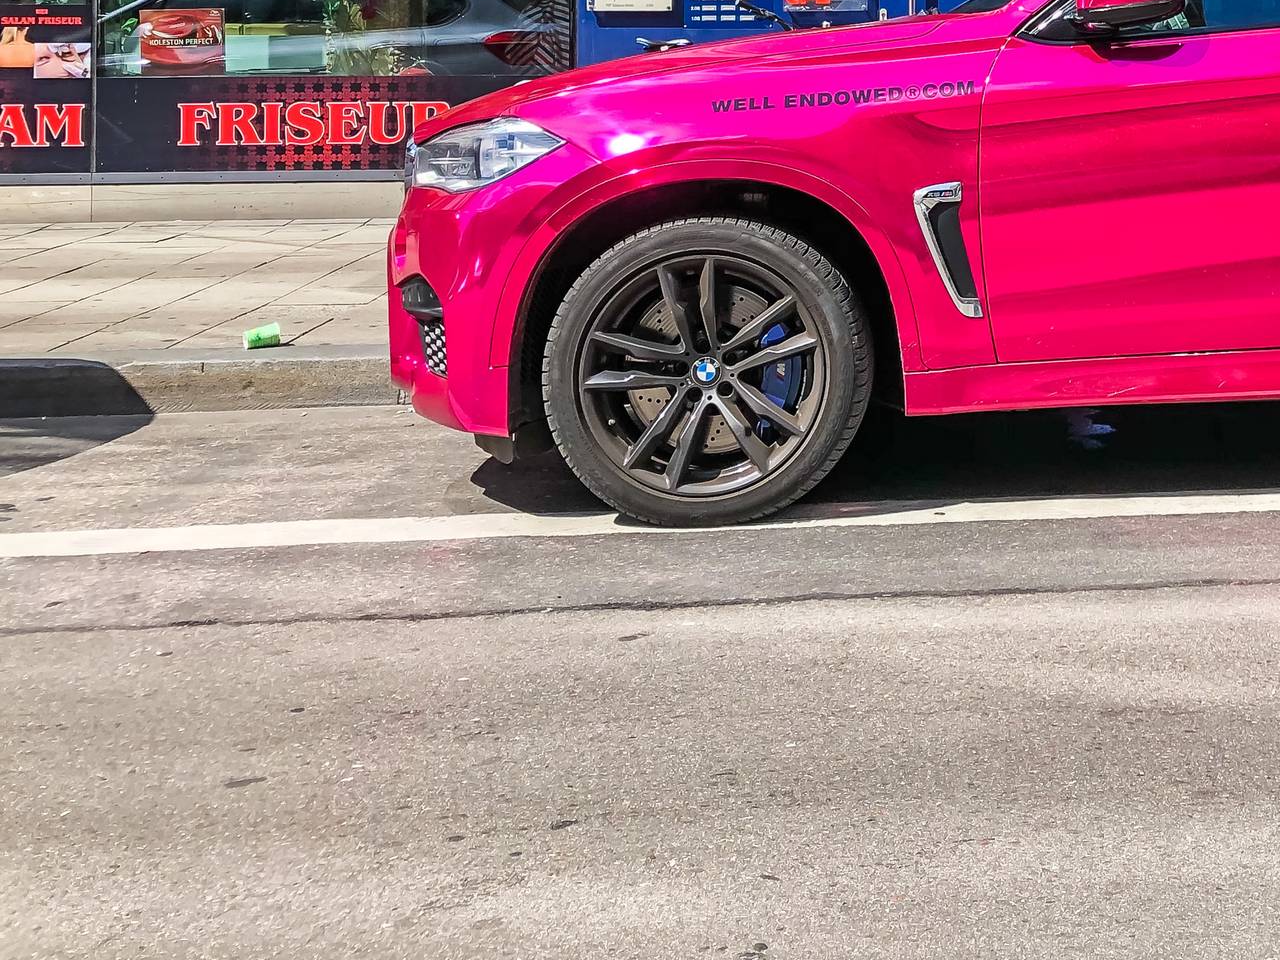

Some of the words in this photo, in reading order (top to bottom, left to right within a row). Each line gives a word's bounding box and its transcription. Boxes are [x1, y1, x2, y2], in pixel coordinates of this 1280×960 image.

[1, 17, 36, 25] SALAM
[38, 17, 83, 26] FRISEUR
[711, 97, 775, 113] WELL
